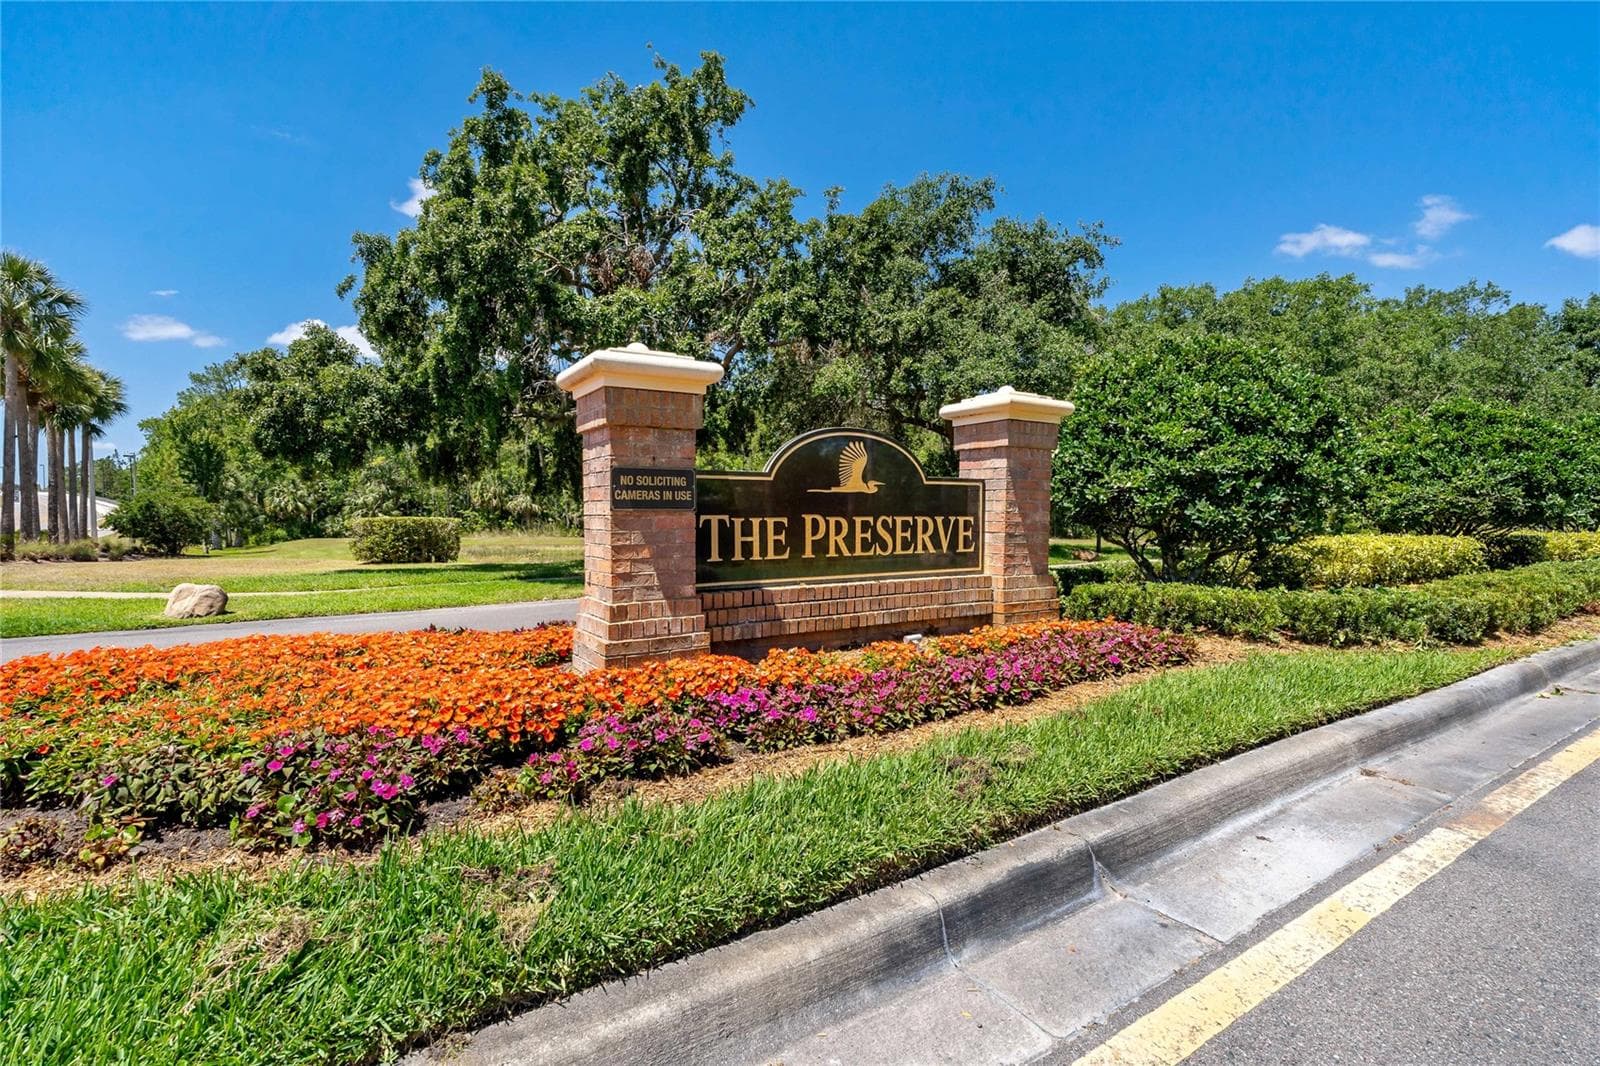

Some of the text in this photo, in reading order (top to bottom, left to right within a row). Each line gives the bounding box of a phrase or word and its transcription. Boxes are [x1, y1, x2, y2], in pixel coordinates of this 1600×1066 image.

[620, 475, 687, 487] NO SOLICITING
[614, 489, 692, 501] CAMERAS IN USE
[699, 513, 976, 563] THE PRESERVE
